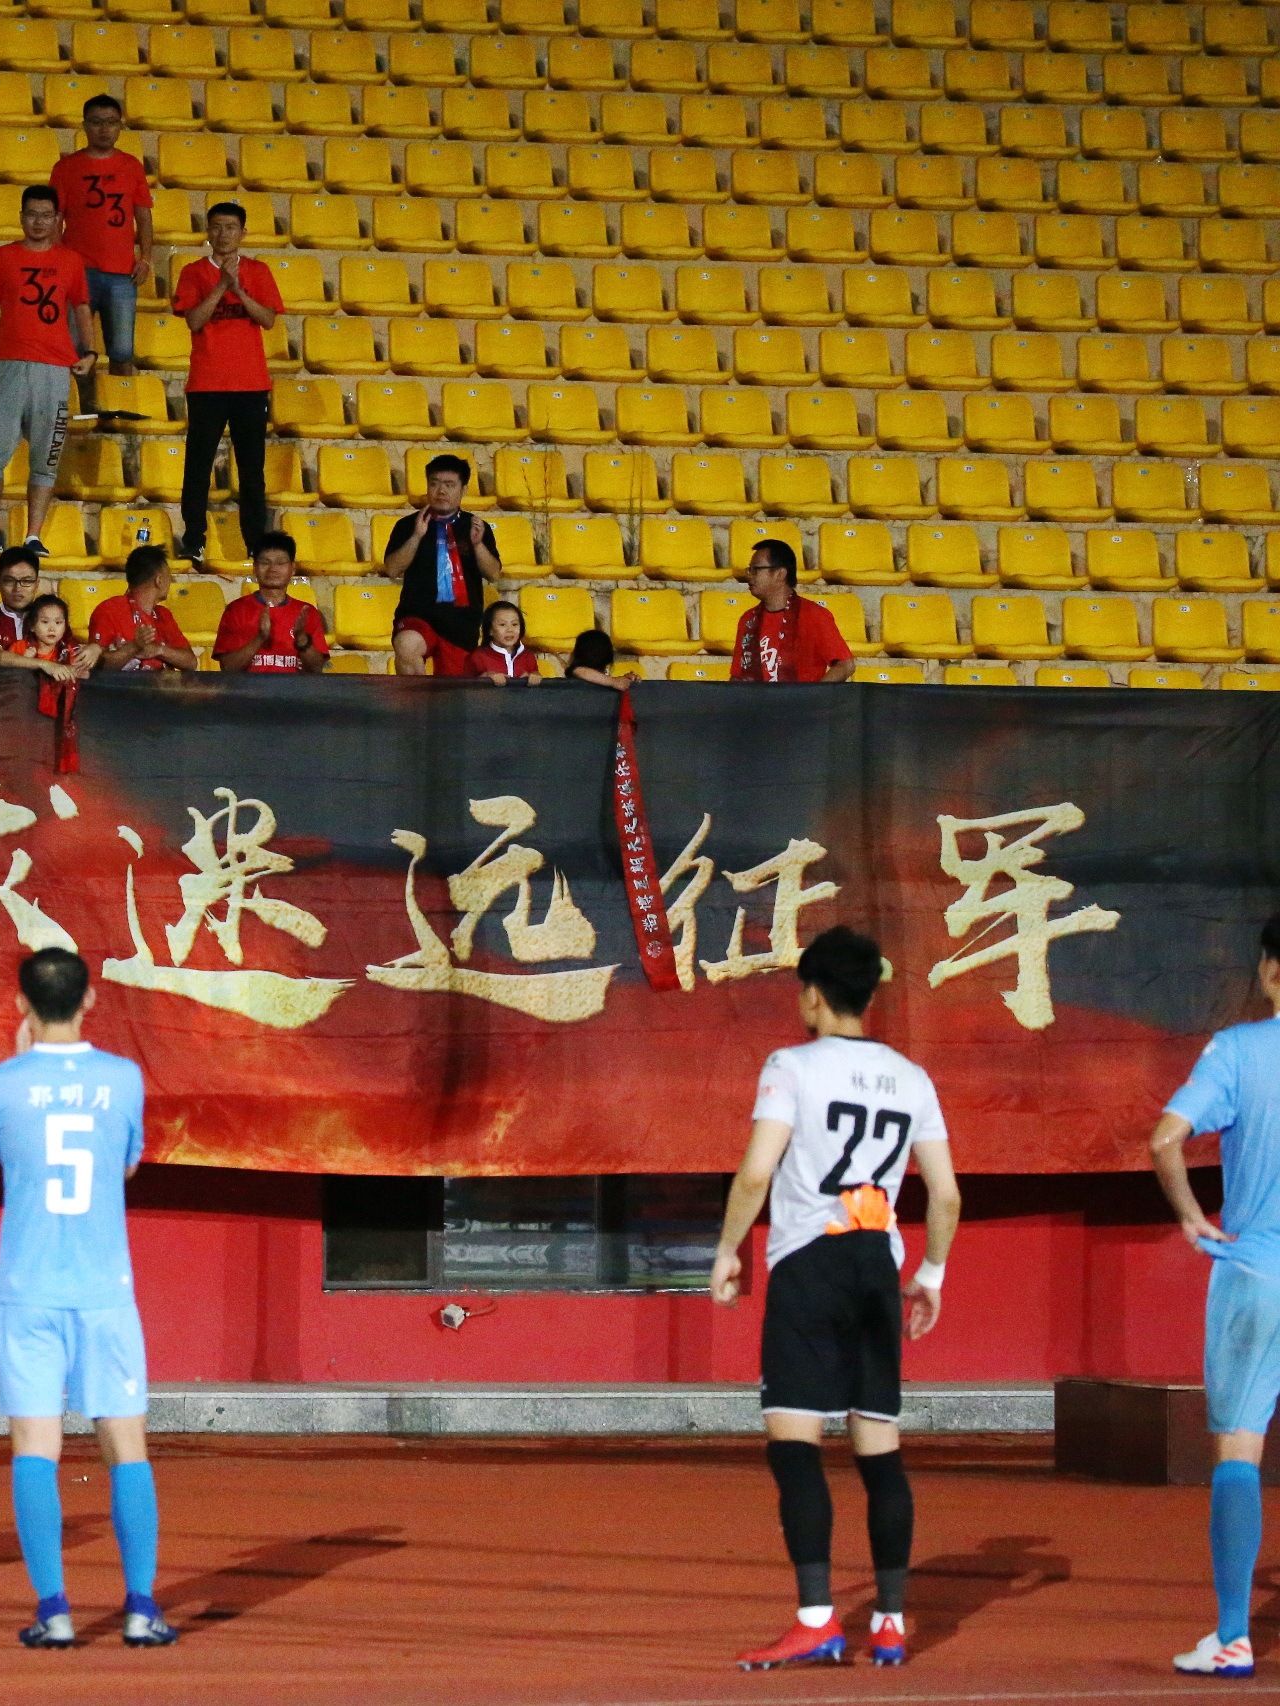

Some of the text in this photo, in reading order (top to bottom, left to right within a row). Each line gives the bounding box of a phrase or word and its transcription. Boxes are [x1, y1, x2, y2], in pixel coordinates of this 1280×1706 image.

[83, 175, 125, 227] 33
[20, 267, 60, 324] 36
[27, 1083, 111, 1110] 郭明月
[46, 1114, 94, 1215] 5
